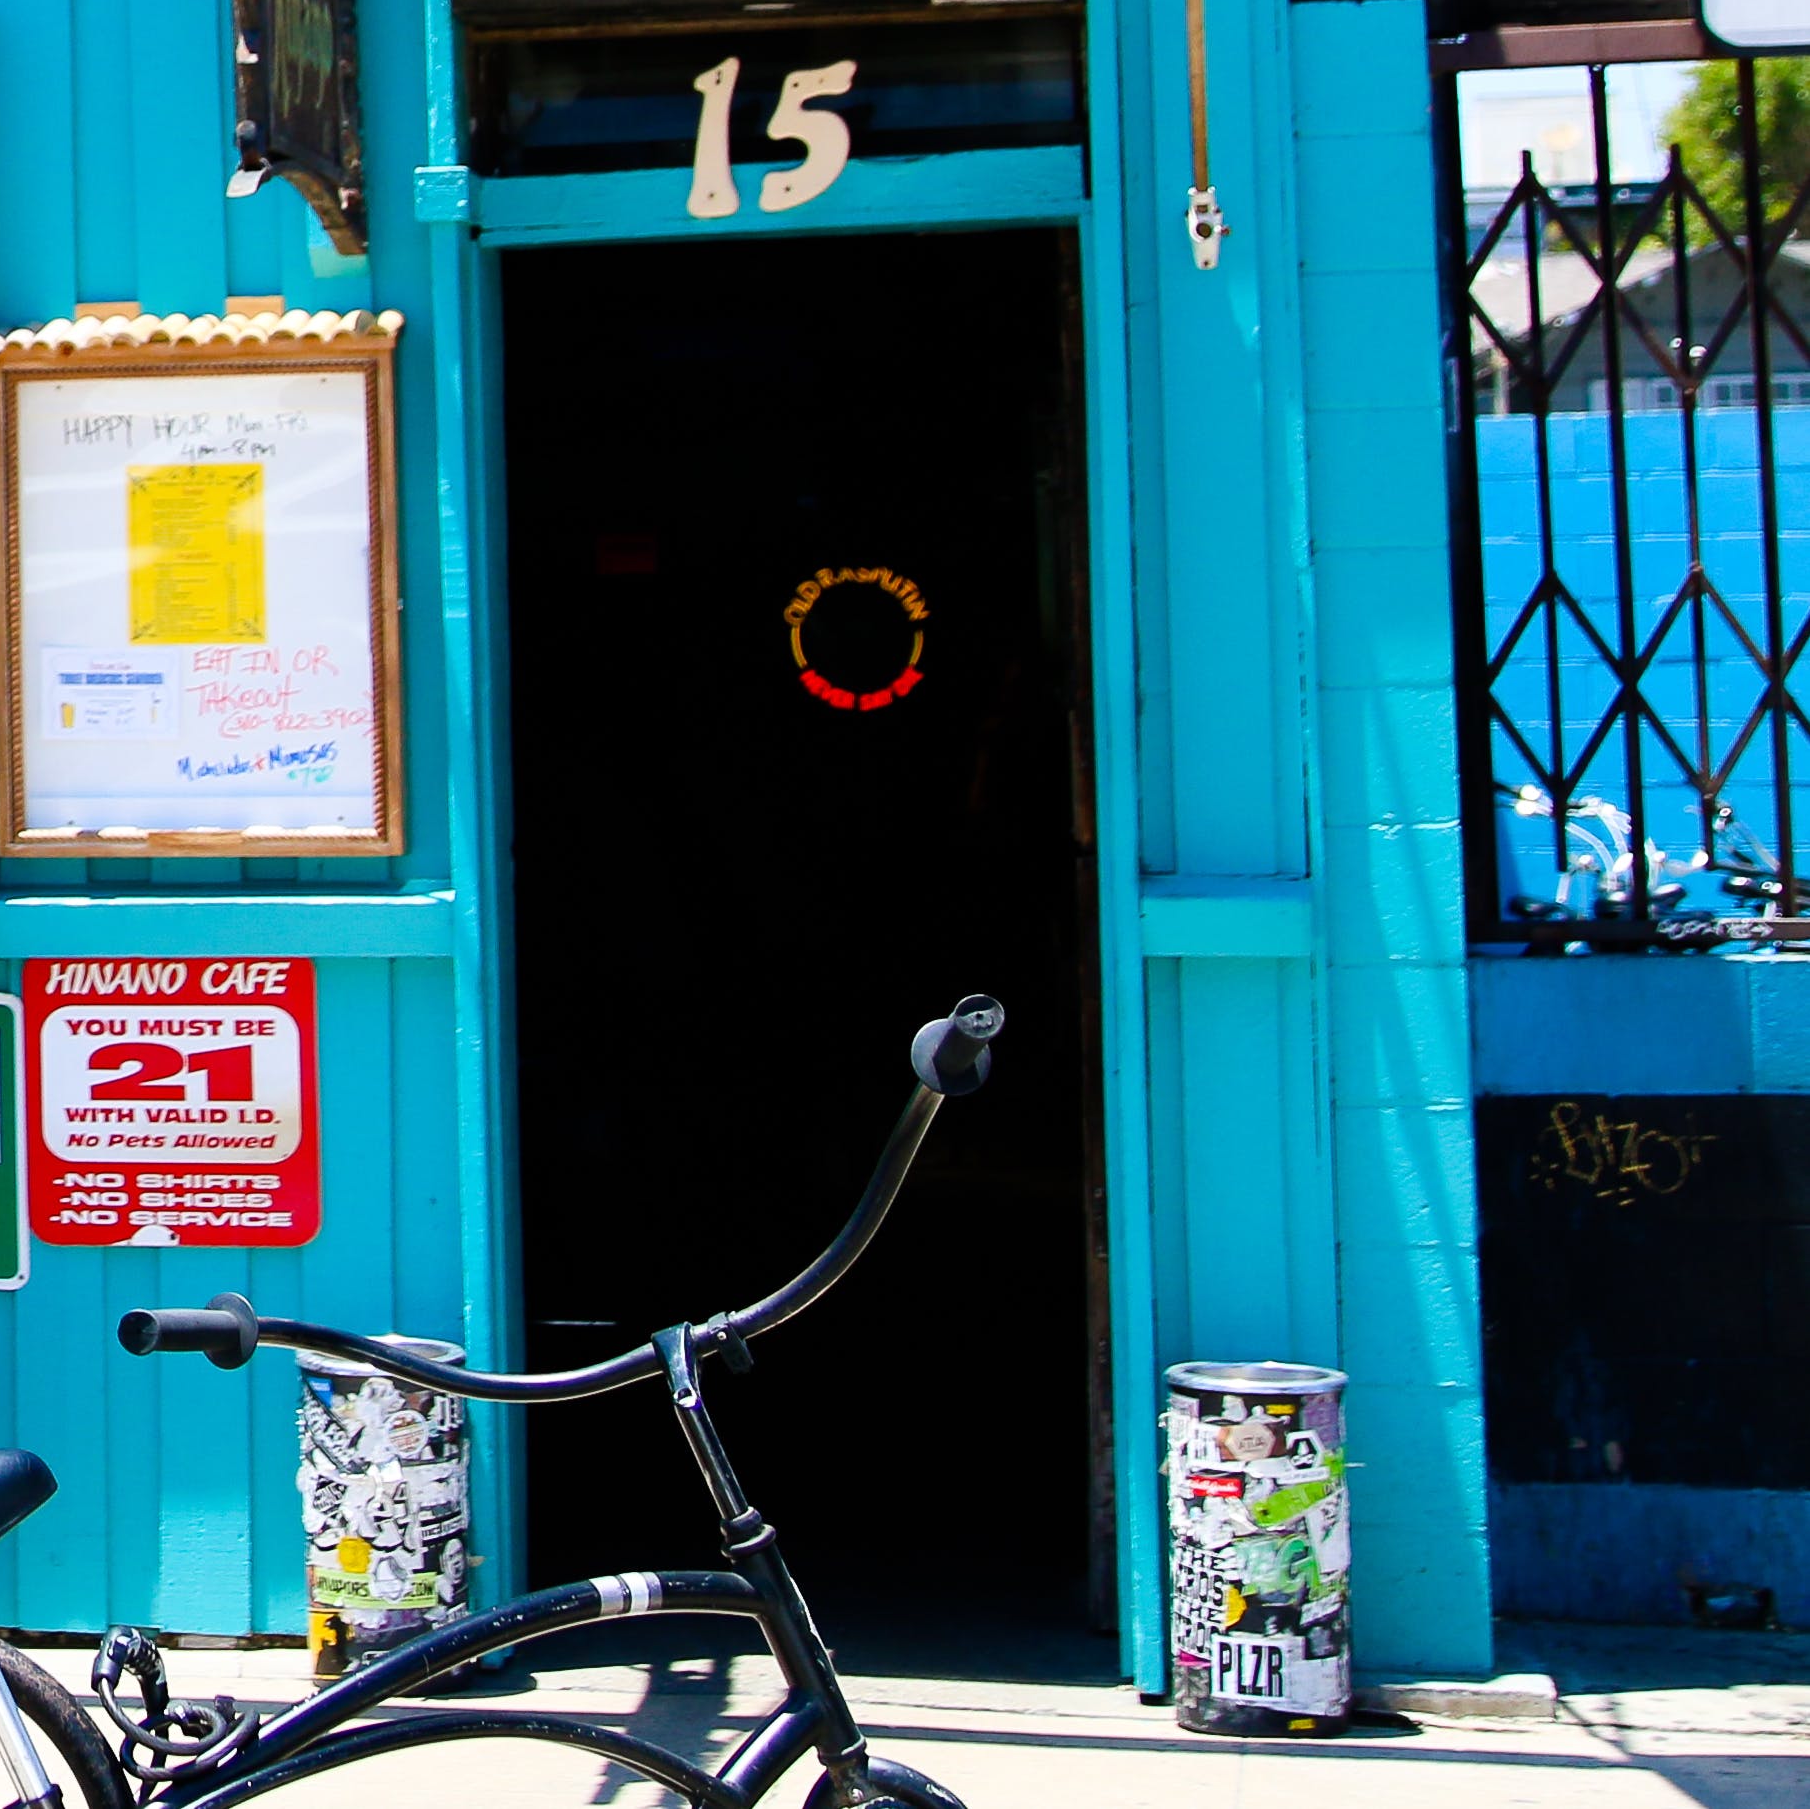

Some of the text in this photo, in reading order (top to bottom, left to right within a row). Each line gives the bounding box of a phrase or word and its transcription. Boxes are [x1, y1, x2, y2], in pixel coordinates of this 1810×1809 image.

[686, 56, 857, 220] 15
[64, 415, 132, 447] HAPPY
[153, 412, 209, 440] HOUR
[784, 580, 821, 625] OLD
[192, 645, 340, 675] EAT IN OR
[45, 962, 291, 995] HINANO CAFE
[66, 1019, 275, 1036] YOU MUST BE
[88, 1042, 253, 1101] 21
[65, 1108, 282, 1124] WITH VALID I.D.
[67, 1133, 276, 1148] No Pets Allowed
[52, 1173, 281, 1189] -NO SHIRTS
[59, 1192, 273, 1208] -NO SHOES
[49, 1210, 293, 1227] -NO SERVICE
[1219, 1642, 1283, 1696] PLZR
